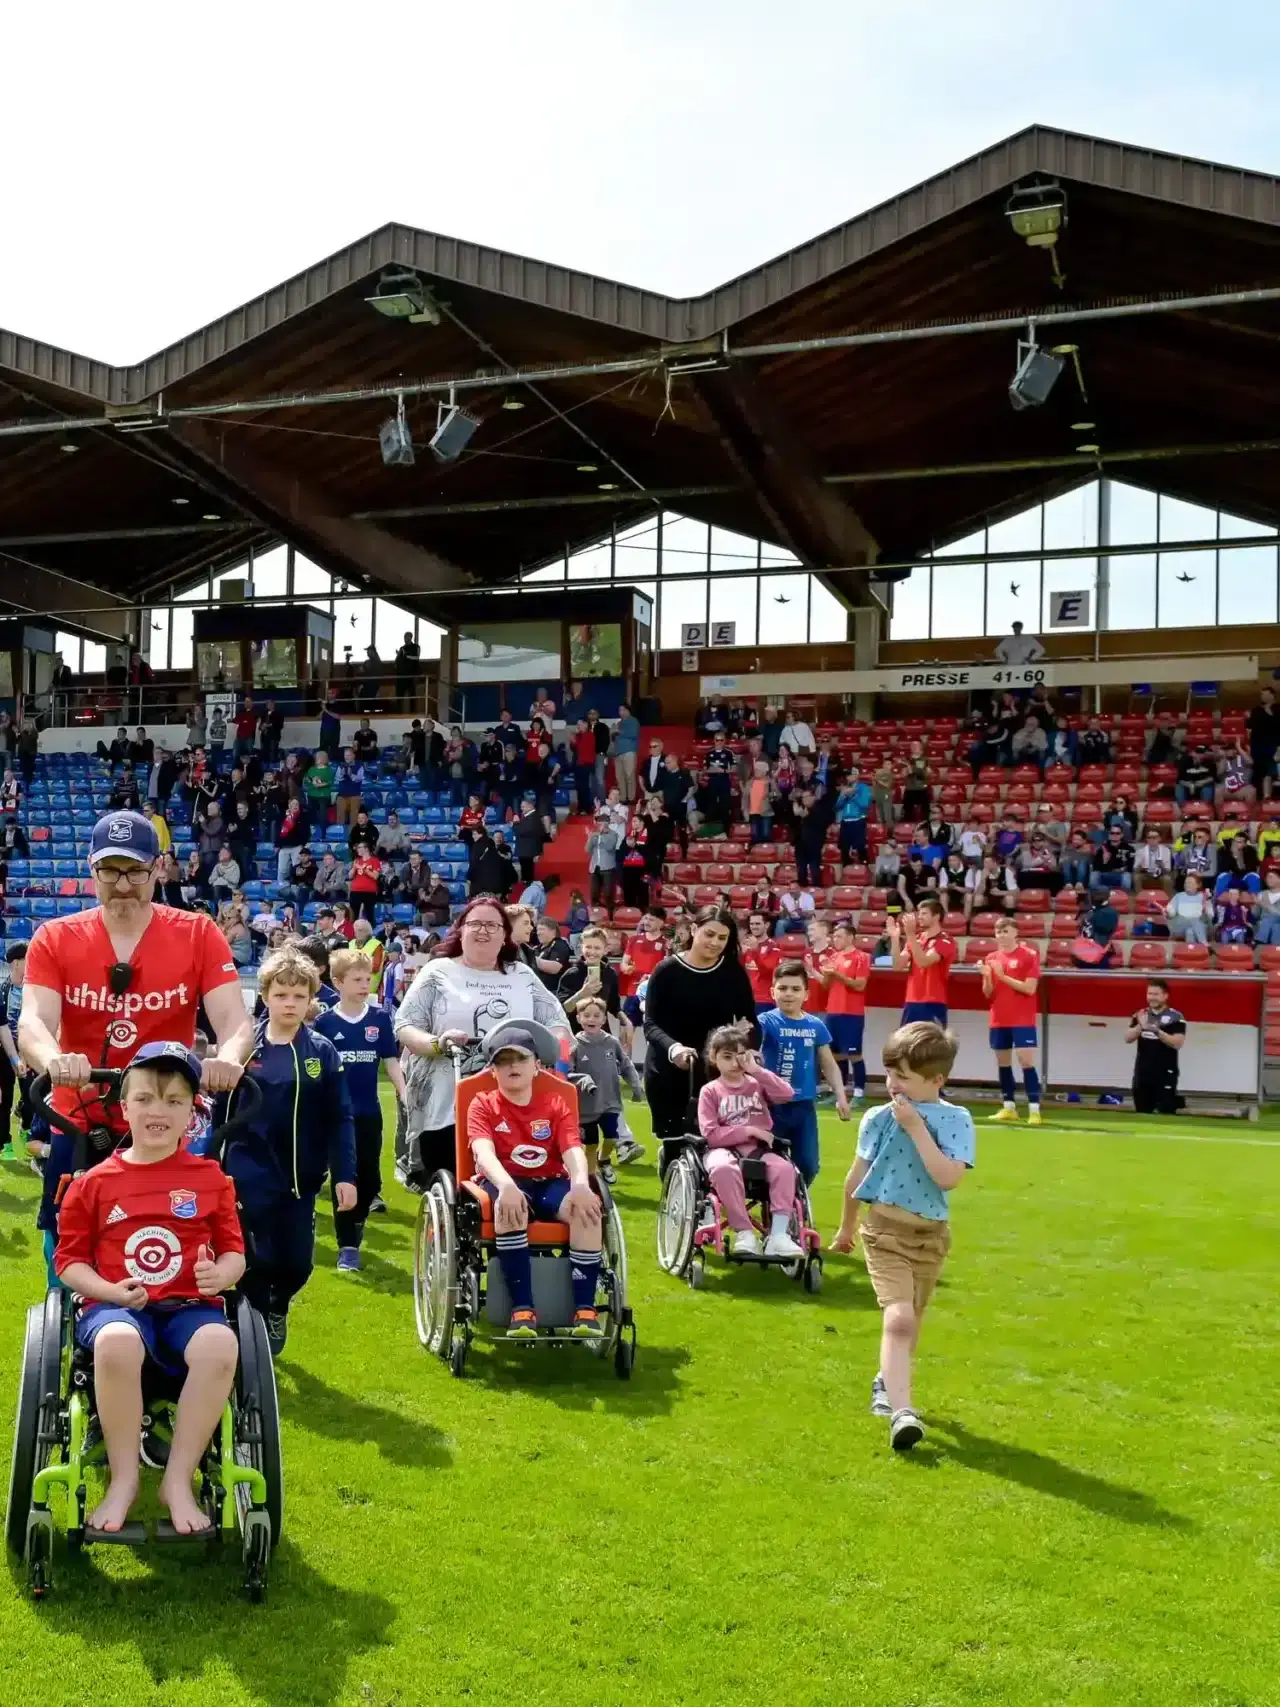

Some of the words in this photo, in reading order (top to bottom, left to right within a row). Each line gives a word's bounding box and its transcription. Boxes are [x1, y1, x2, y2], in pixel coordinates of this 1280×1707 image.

[1056, 598, 1082, 621] E
[687, 627, 701, 640] D
[717, 626, 730, 639] E
[902, 672, 970, 687] PRESSE
[992, 669, 1045, 683] 41-60
[65, 983, 189, 1018] uhlsport
